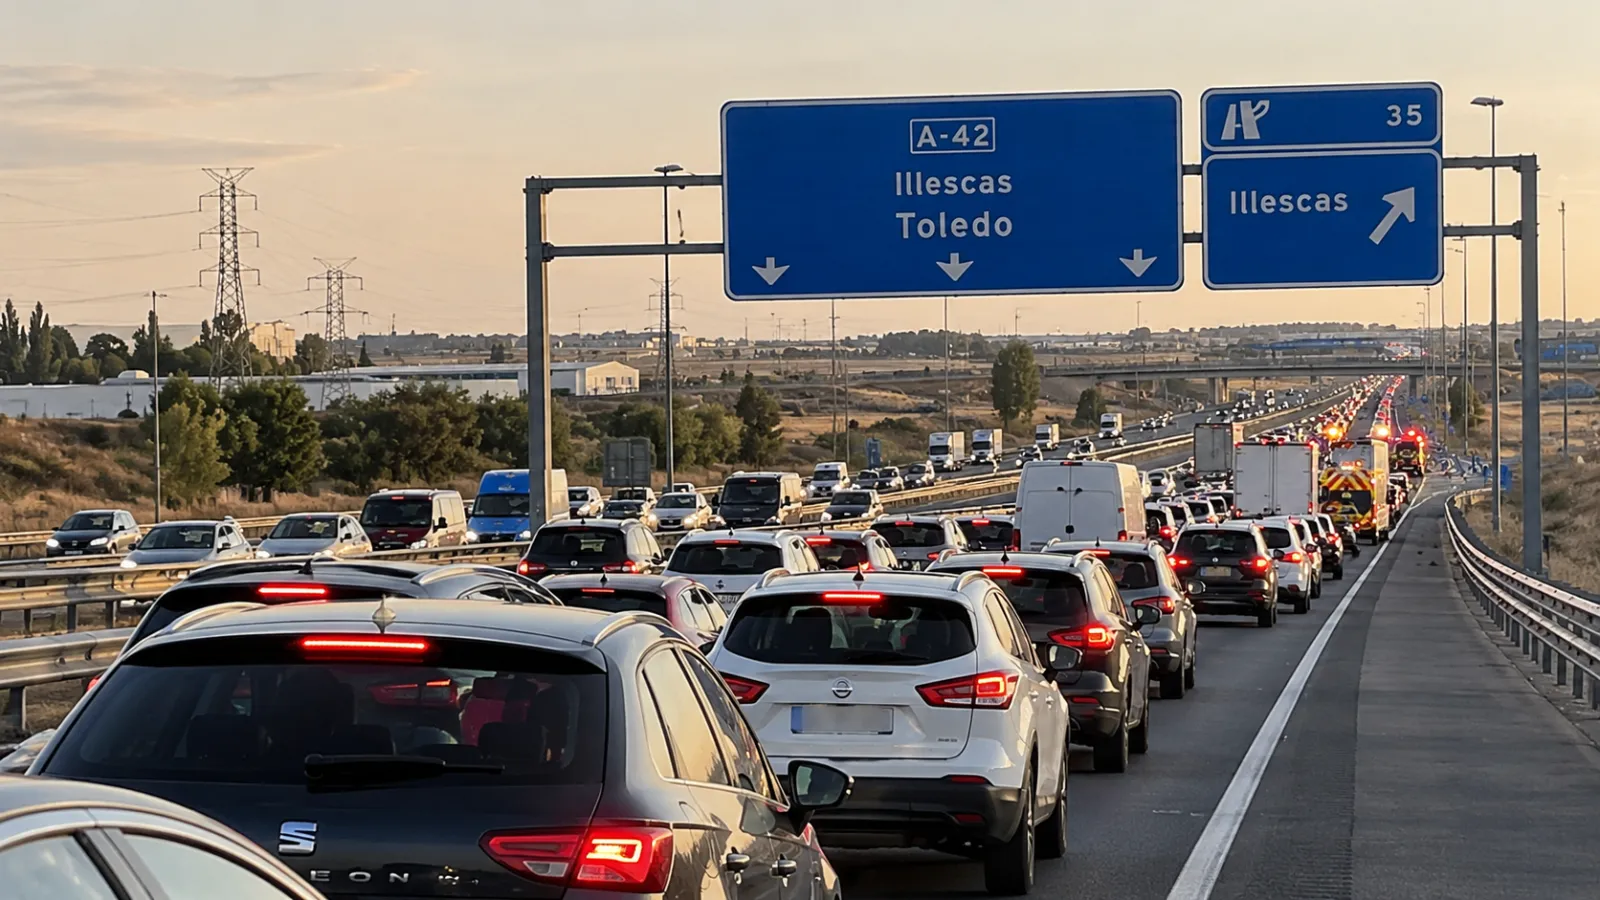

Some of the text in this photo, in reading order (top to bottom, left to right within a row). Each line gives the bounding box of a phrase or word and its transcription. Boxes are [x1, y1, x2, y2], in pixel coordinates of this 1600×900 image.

[1386, 104, 1422, 127] 35
[917, 119, 991, 148] A-42
[895, 170, 1012, 197] Illescas
[1230, 189, 1349, 214] Illescas
[896, 210, 1012, 240] Toledo
[310, 870, 409, 883] EON
